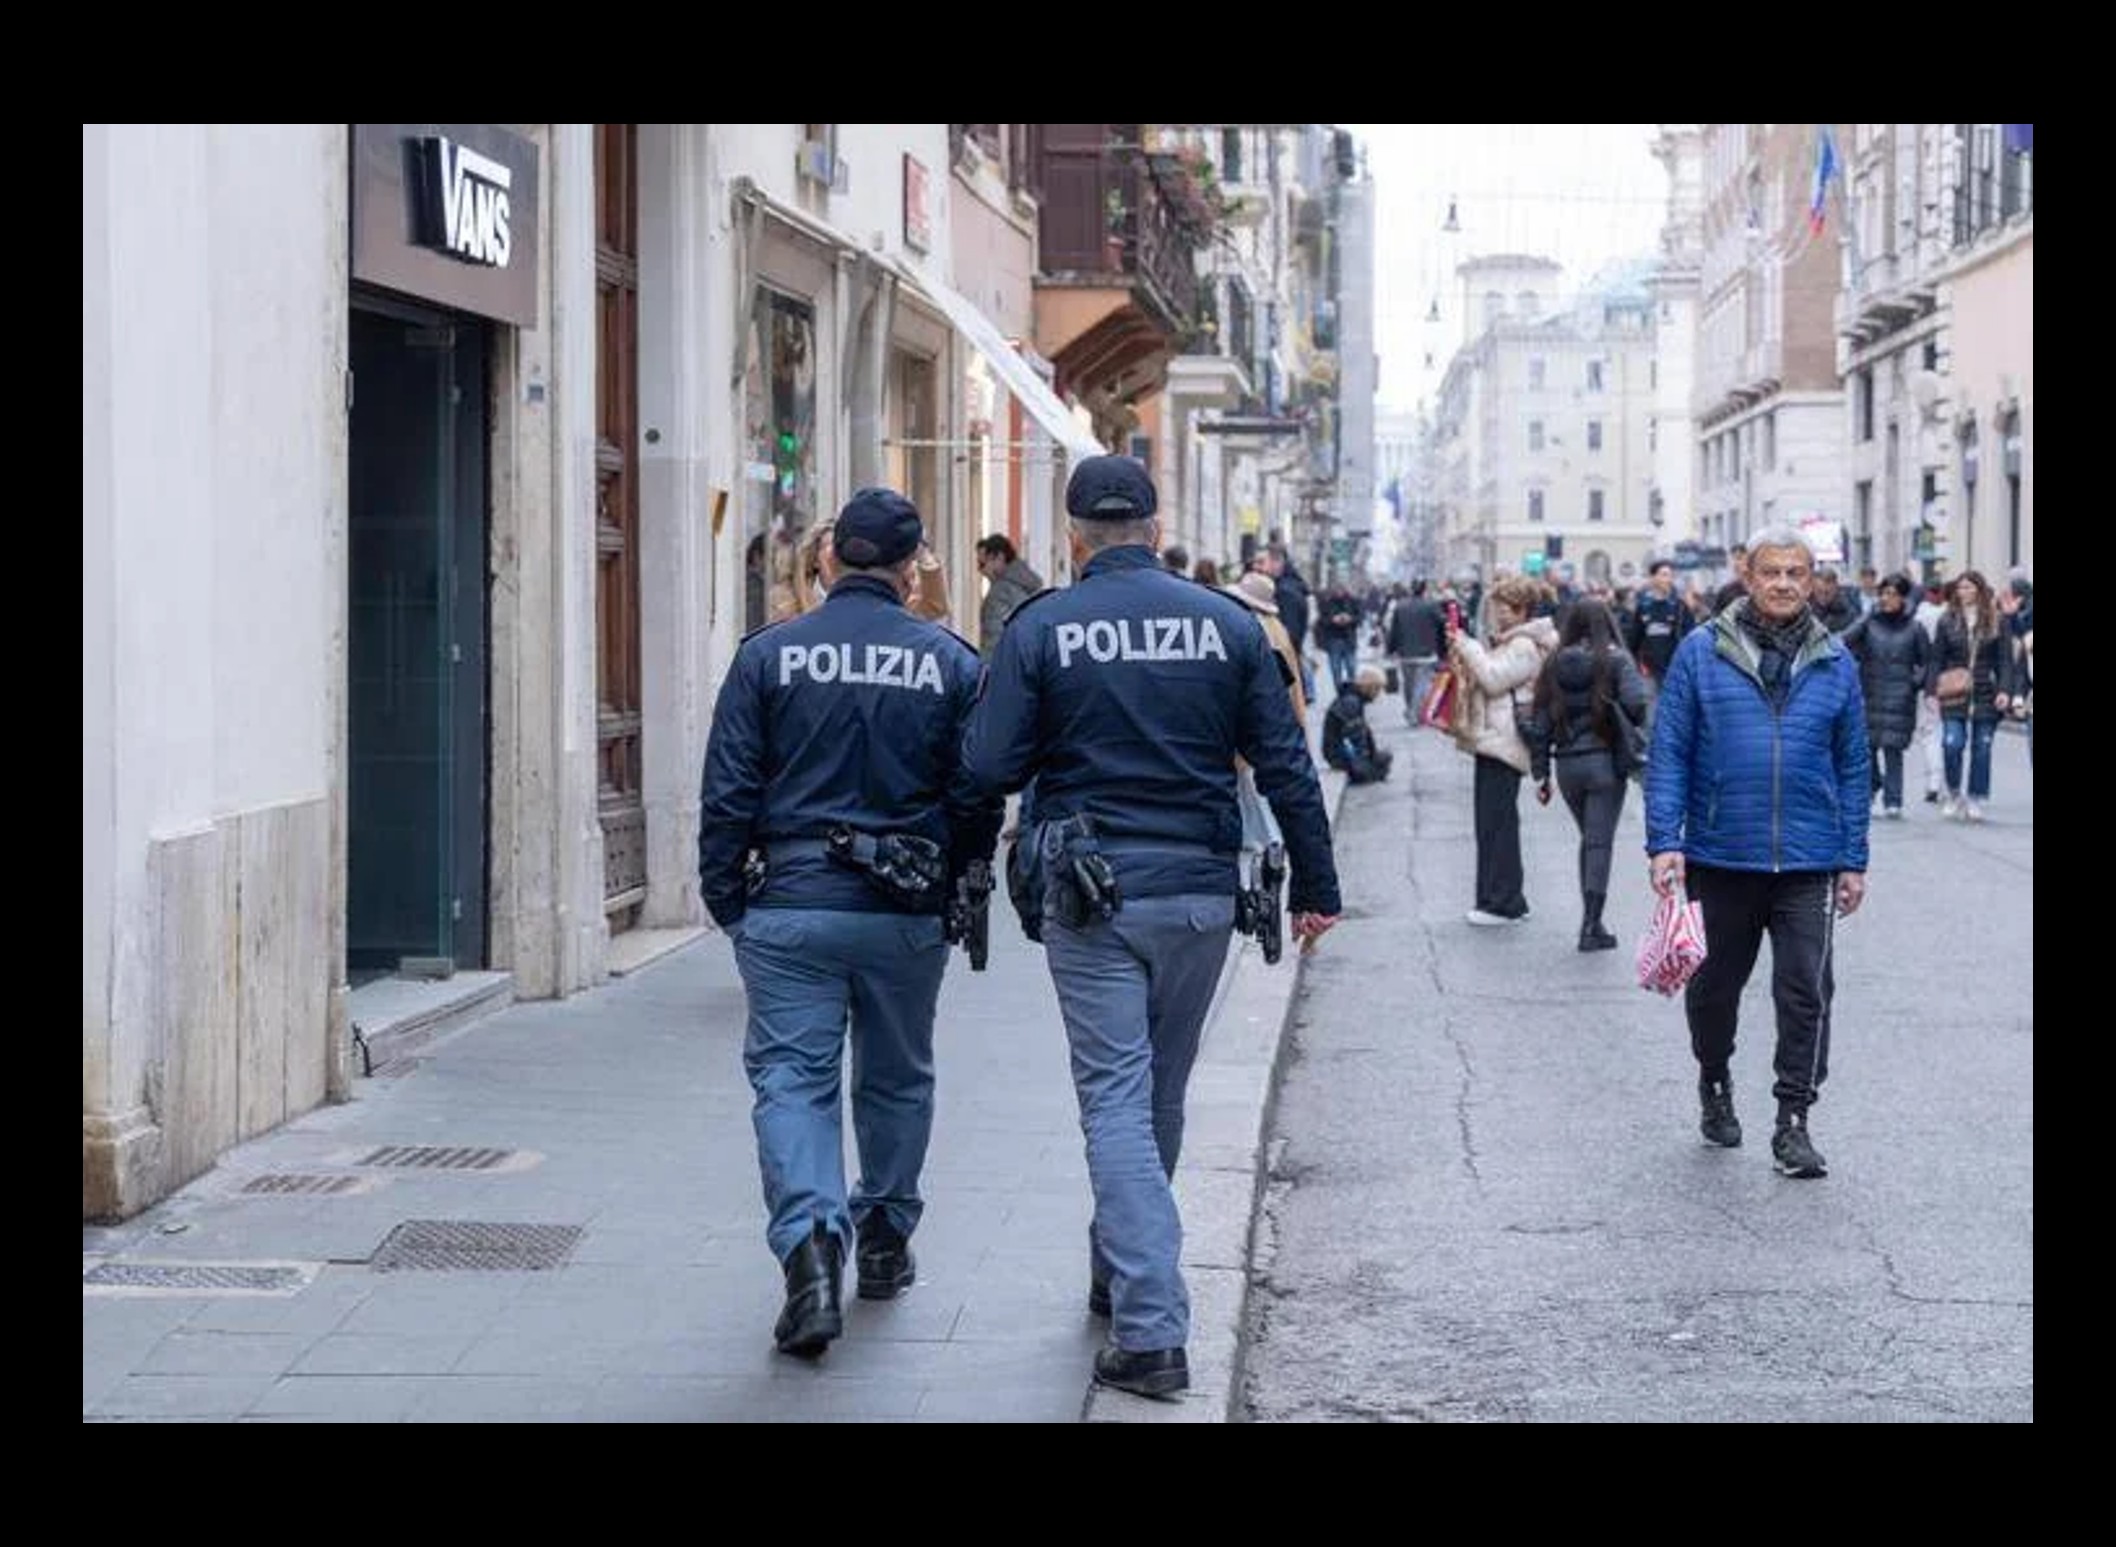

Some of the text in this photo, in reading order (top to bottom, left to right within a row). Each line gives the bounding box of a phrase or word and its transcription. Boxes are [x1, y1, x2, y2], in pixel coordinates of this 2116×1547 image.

[440, 136, 511, 267] VANS
[779, 642, 944, 695] POLIZIA
[1056, 616, 1227, 668] POLIZIA
